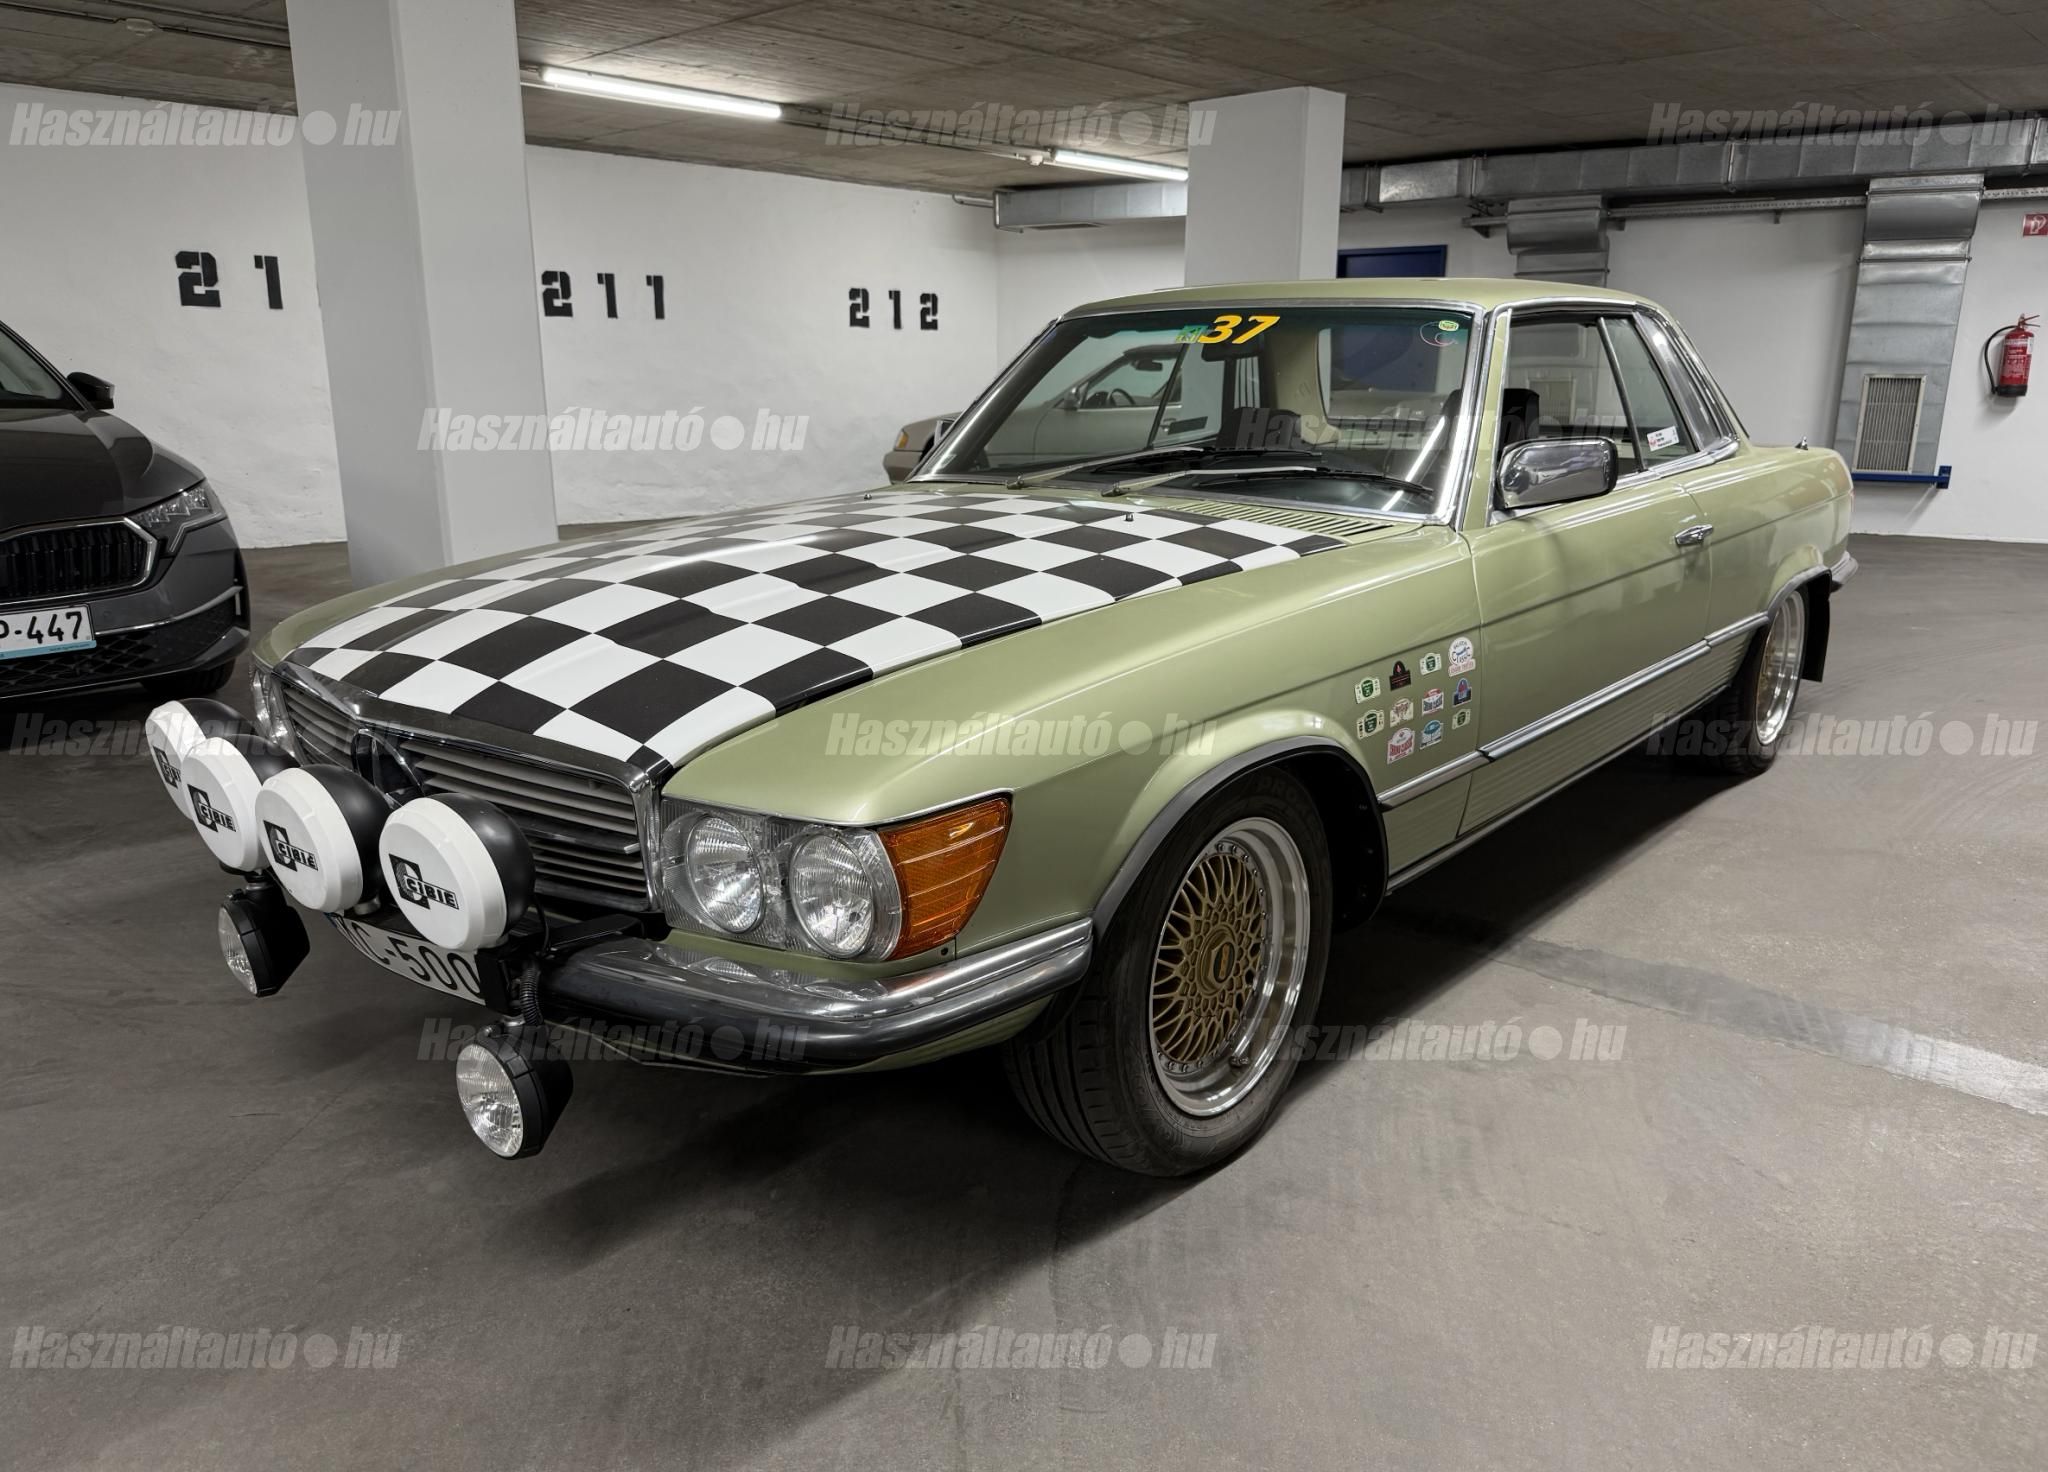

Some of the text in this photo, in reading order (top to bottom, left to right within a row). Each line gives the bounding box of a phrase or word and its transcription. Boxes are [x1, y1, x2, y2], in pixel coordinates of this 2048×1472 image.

[541, 270, 666, 320] 211
[848, 288, 939, 330] 212
[1197, 314, 1280, 344] 37
